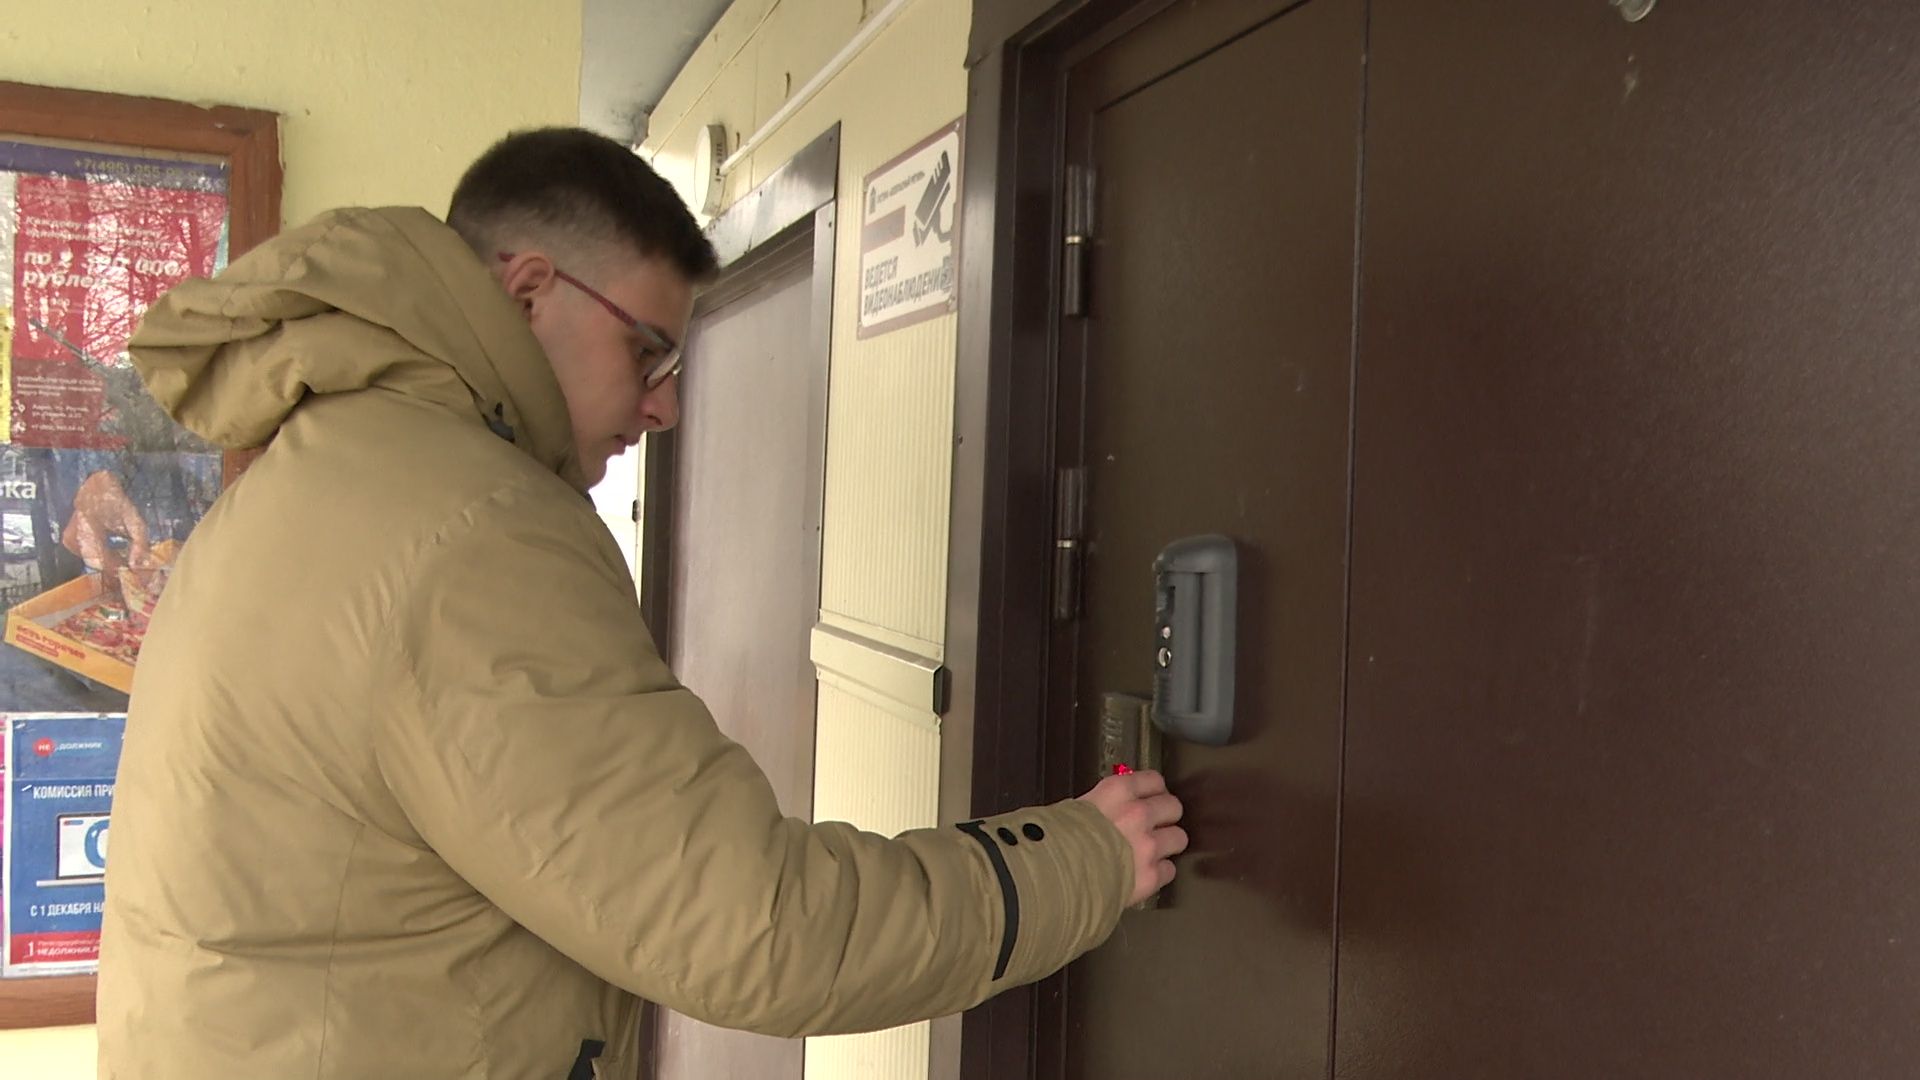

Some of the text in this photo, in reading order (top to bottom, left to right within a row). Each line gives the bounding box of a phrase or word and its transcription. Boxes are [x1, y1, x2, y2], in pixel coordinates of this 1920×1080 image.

[0, 480, 37, 500] ка
[33, 784, 92, 800] КОМИССИЯ
[30, 904, 38, 917] С
[40, 904, 46, 917] 1
[47, 902, 91, 917] ДЕКАБРЯ
